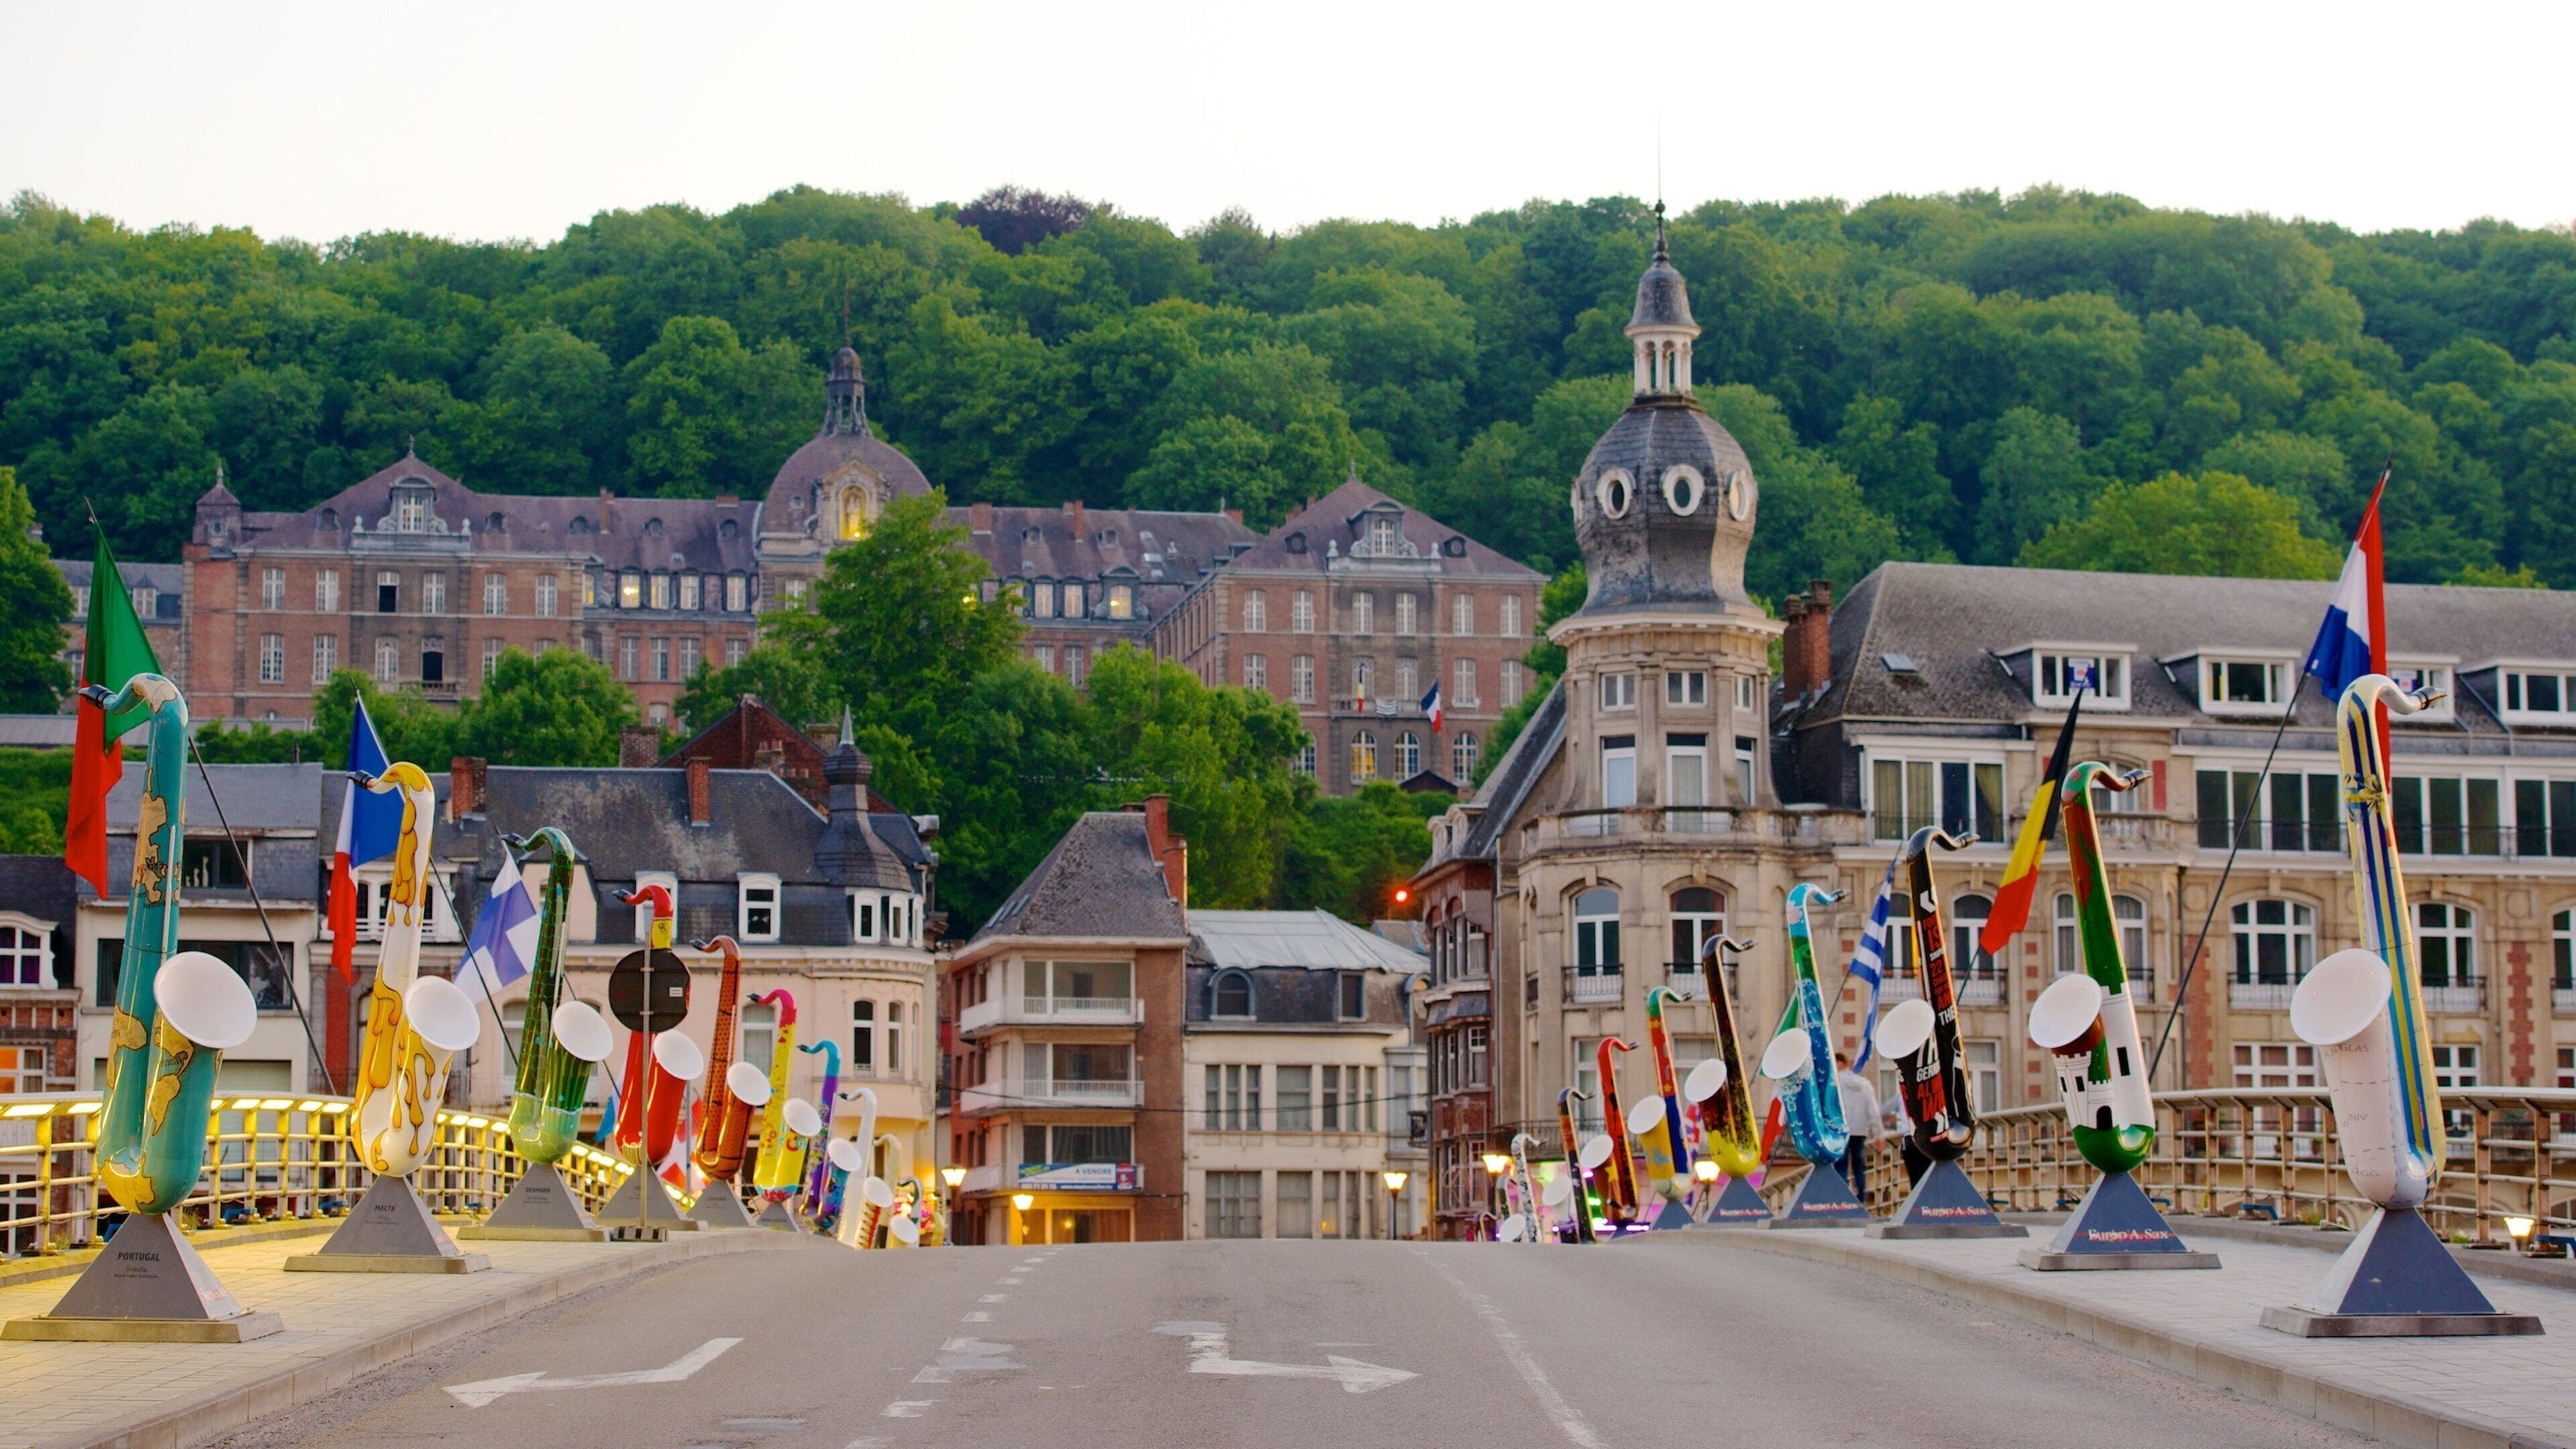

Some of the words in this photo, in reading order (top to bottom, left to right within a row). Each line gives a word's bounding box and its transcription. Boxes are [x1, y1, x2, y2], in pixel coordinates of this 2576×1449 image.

[1930, 959, 1943, 977] 22
[1938, 1005, 1955, 1026] THE
[2144, 1228, 2169, 1240] Sax
[117, 1252, 160, 1262] PORTUGAL
